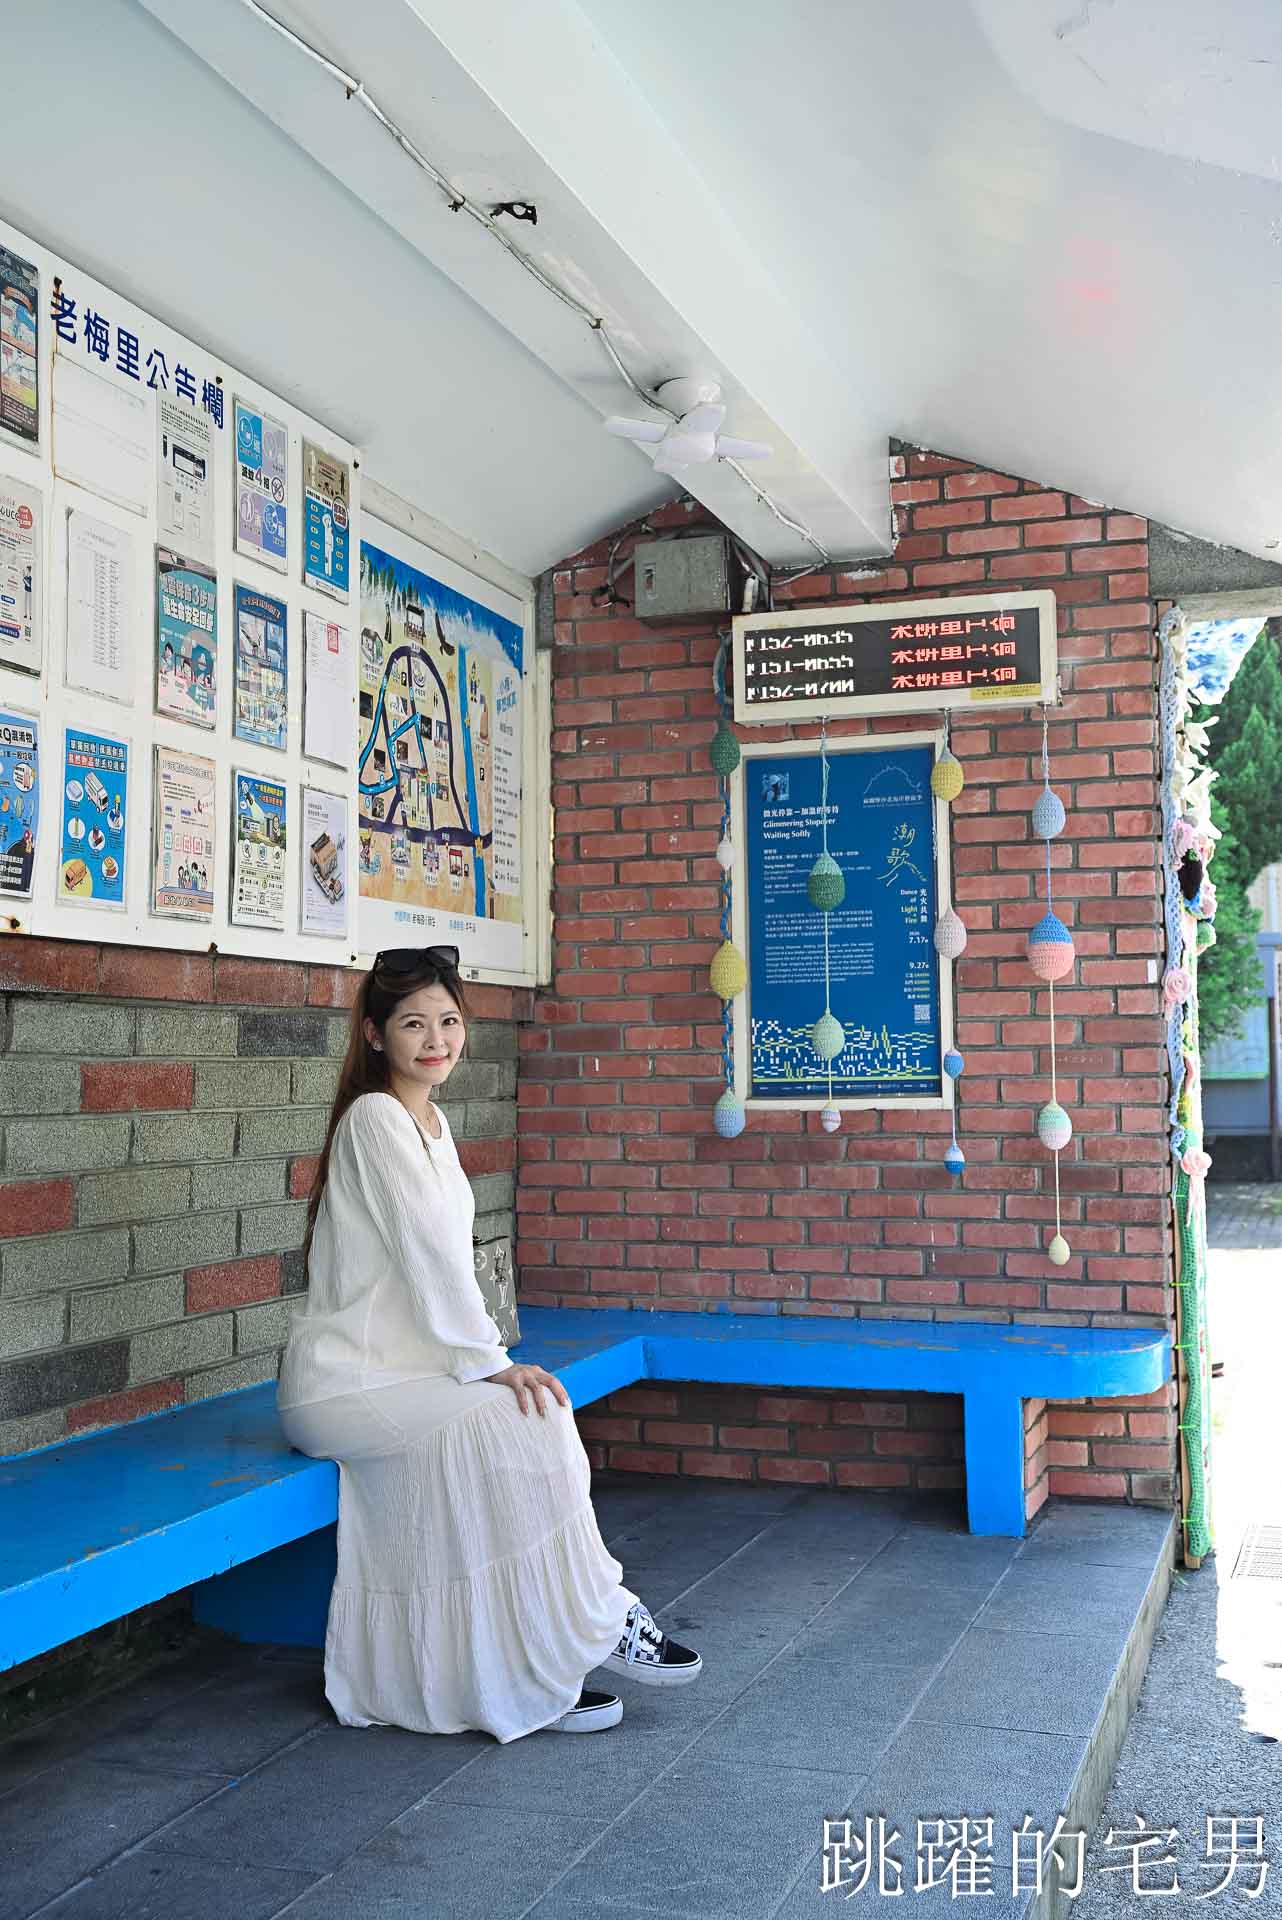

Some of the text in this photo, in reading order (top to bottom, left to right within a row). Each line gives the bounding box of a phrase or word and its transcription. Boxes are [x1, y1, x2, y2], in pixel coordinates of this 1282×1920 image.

[50, 290, 224, 430] 老梅里公告欄
[763, 819, 804, 829] Glimmering
[763, 829, 811, 840] Waiting Softly
